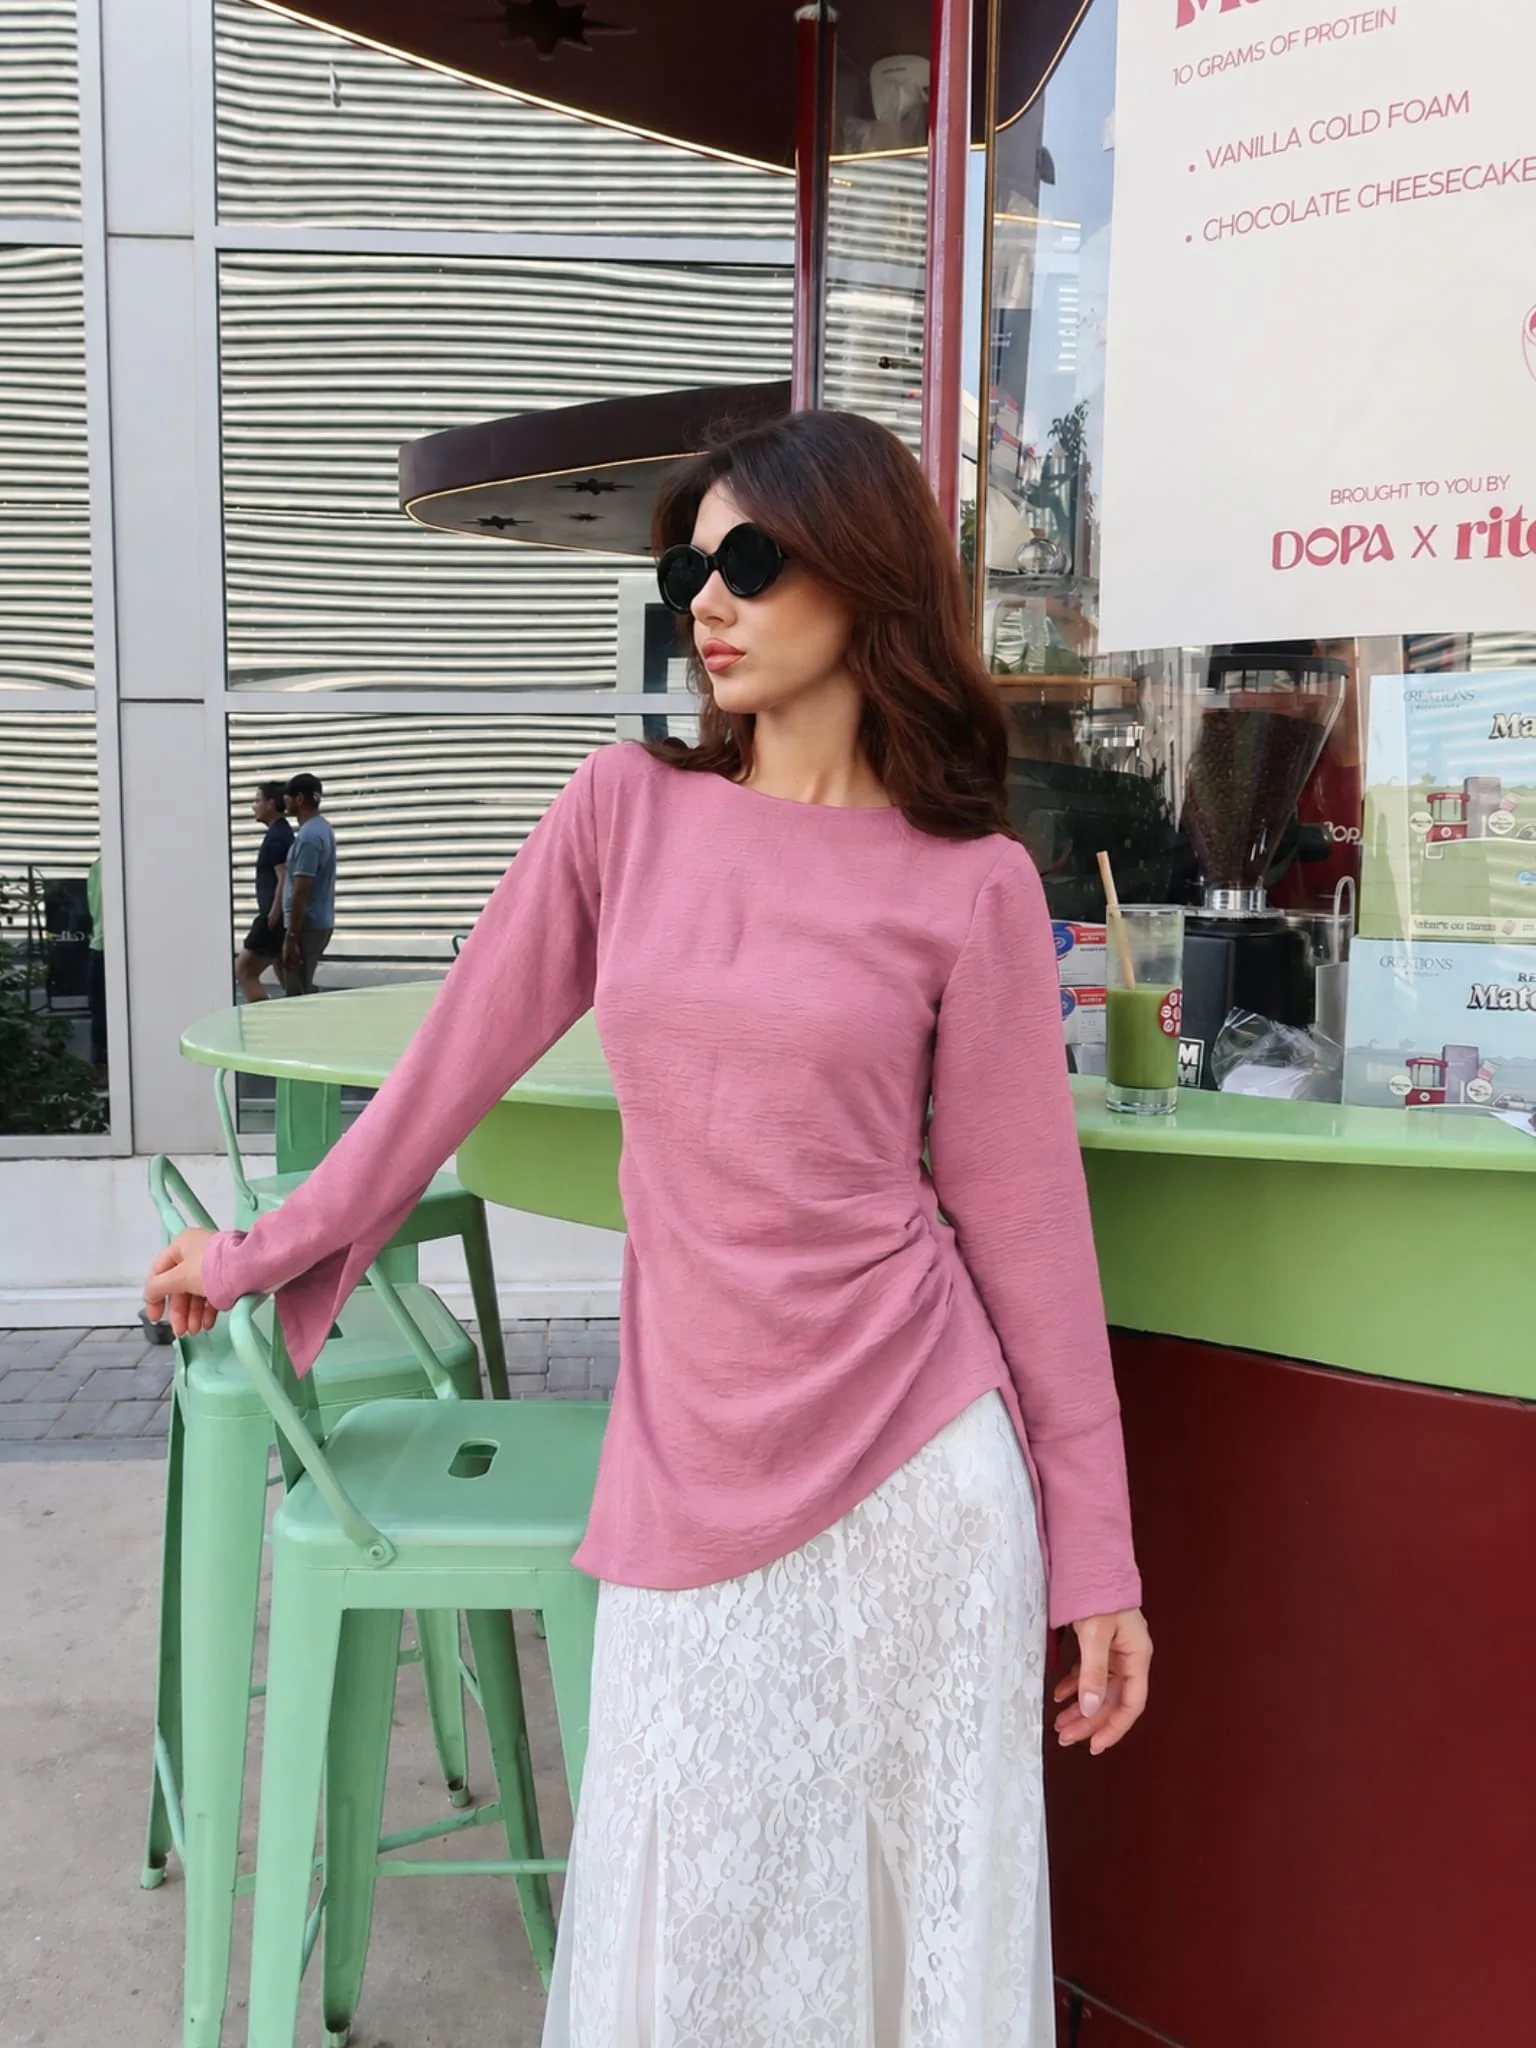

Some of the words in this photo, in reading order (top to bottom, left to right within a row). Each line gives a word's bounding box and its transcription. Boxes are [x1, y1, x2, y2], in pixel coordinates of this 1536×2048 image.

[1172, 64, 1193, 86] 10
[1197, 41, 1265, 78] GRAMS
[1269, 30, 1300, 56] OF
[1303, 6, 1397, 47] PROTEIN
[1206, 127, 1302, 169] VANILLA
[1308, 108, 1381, 145] COLD
[1387, 90, 1471, 129] FOAM
[1202, 188, 1351, 242] CHOCOLATE
[1357, 156, 1536, 209] CHEESECAKE
[1330, 482, 1412, 505] BROUGHT
[1416, 480, 1440, 497] TO
[1444, 476, 1483, 494] YOU
[1485, 474, 1511, 492] BY
[1271, 523, 1395, 571] DOPA
